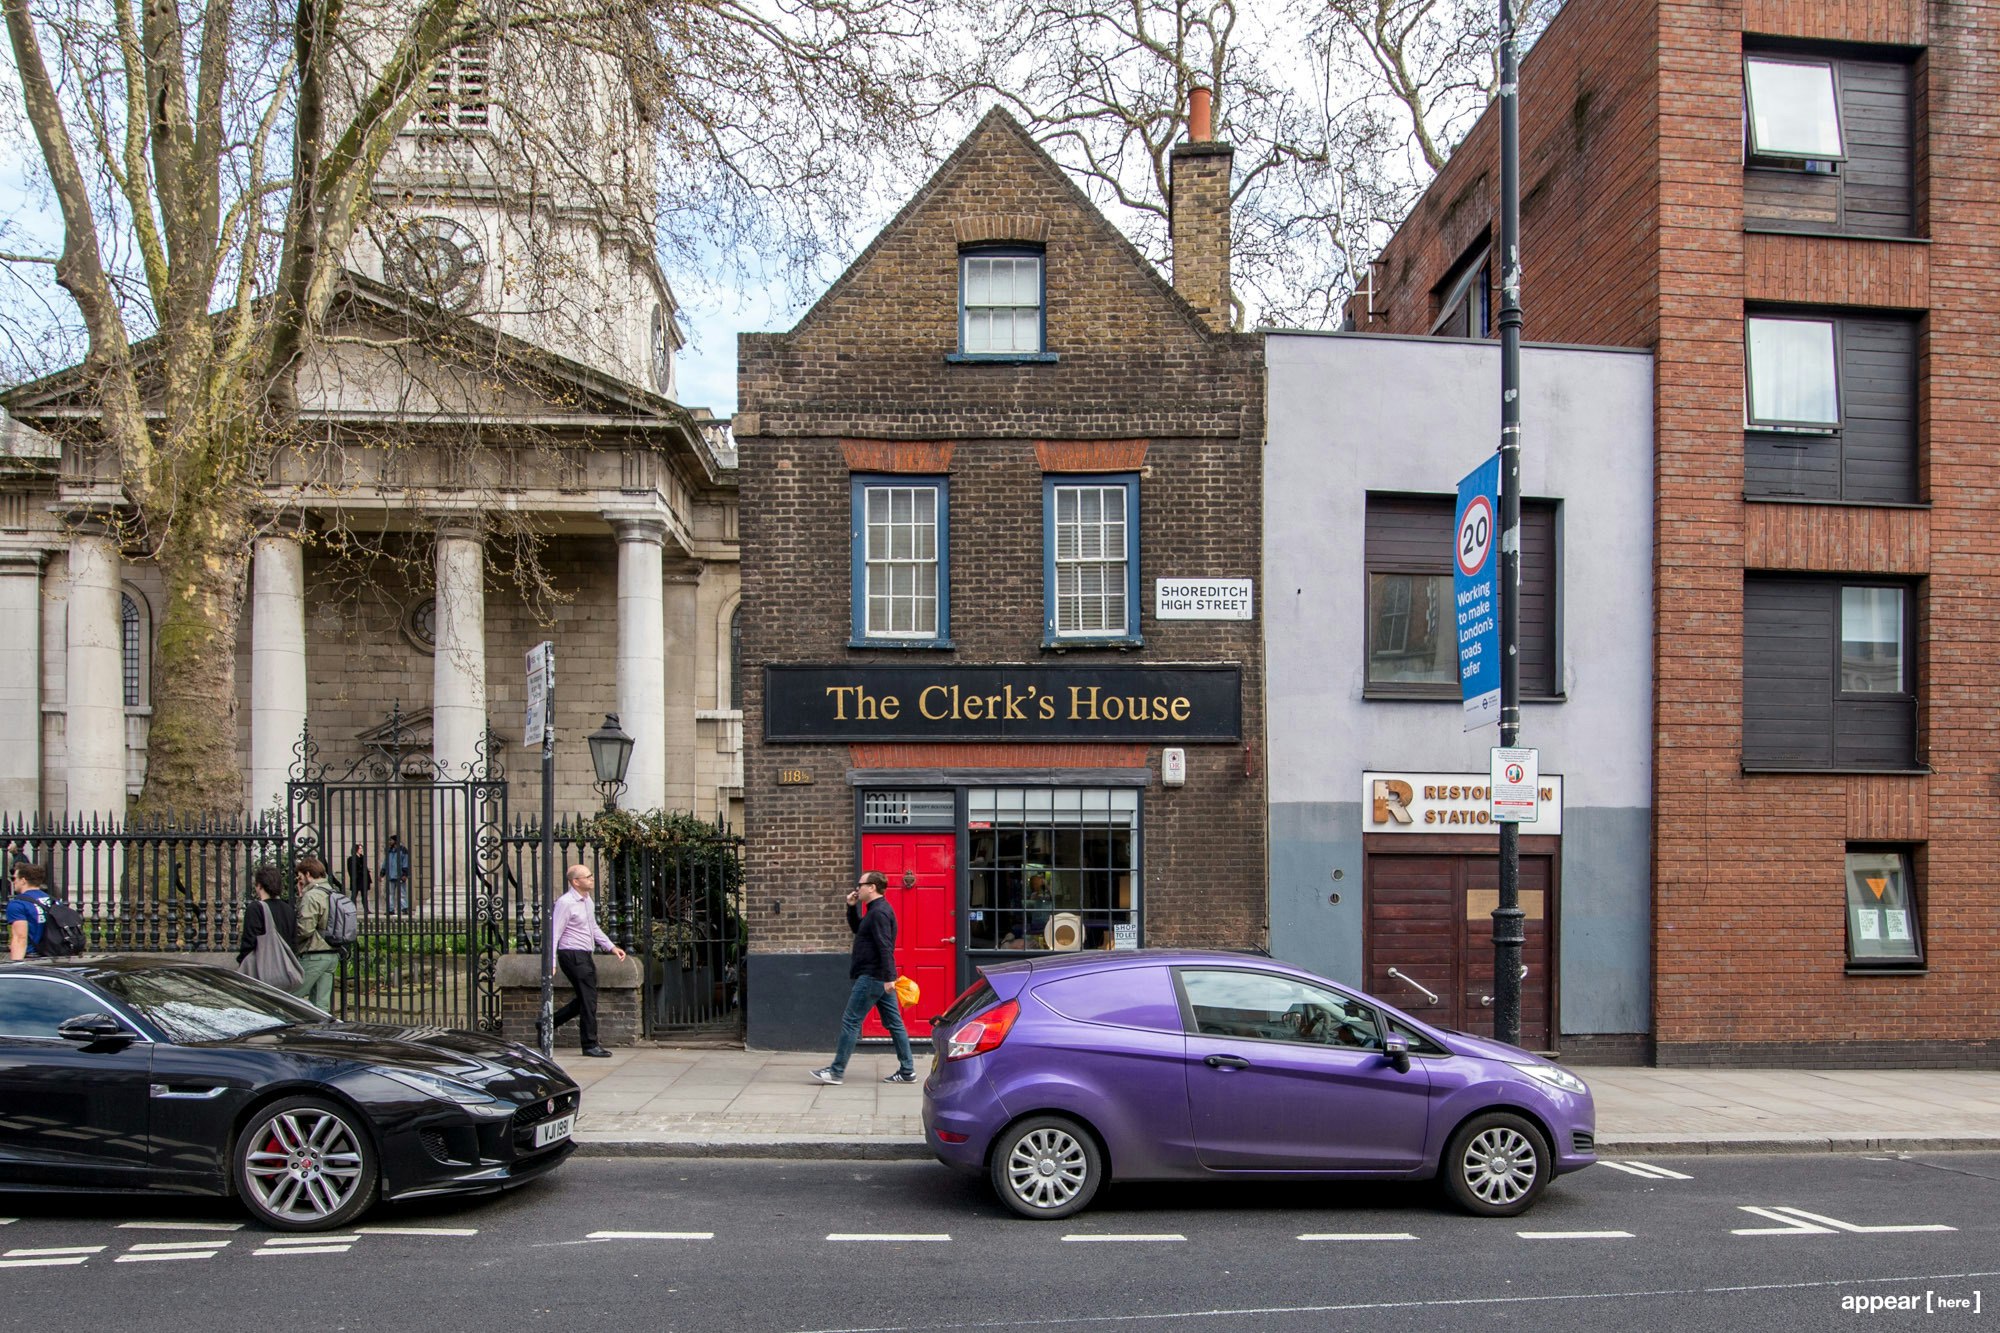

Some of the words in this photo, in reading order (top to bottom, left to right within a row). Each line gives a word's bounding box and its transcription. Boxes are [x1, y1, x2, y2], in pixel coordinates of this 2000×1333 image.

[1463, 516, 1488, 556] 20
[1161, 586, 1248, 597] SHOREDITCH
[1457, 581, 1491, 607] Working
[1161, 599, 1192, 610] HIGH
[1196, 599, 1248, 610] STREET
[1458, 613, 1467, 625] to
[1468, 600, 1491, 621] make
[1459, 616, 1494, 643] London's
[1461, 641, 1482, 662] roads
[1462, 660, 1481, 679] safer
[825, 685, 901, 720] The
[1066, 686, 1192, 721] House
[1372, 779, 1415, 824] R
[1424, 785, 1553, 801] RESTON
[1424, 809, 1501, 825] STATIO
